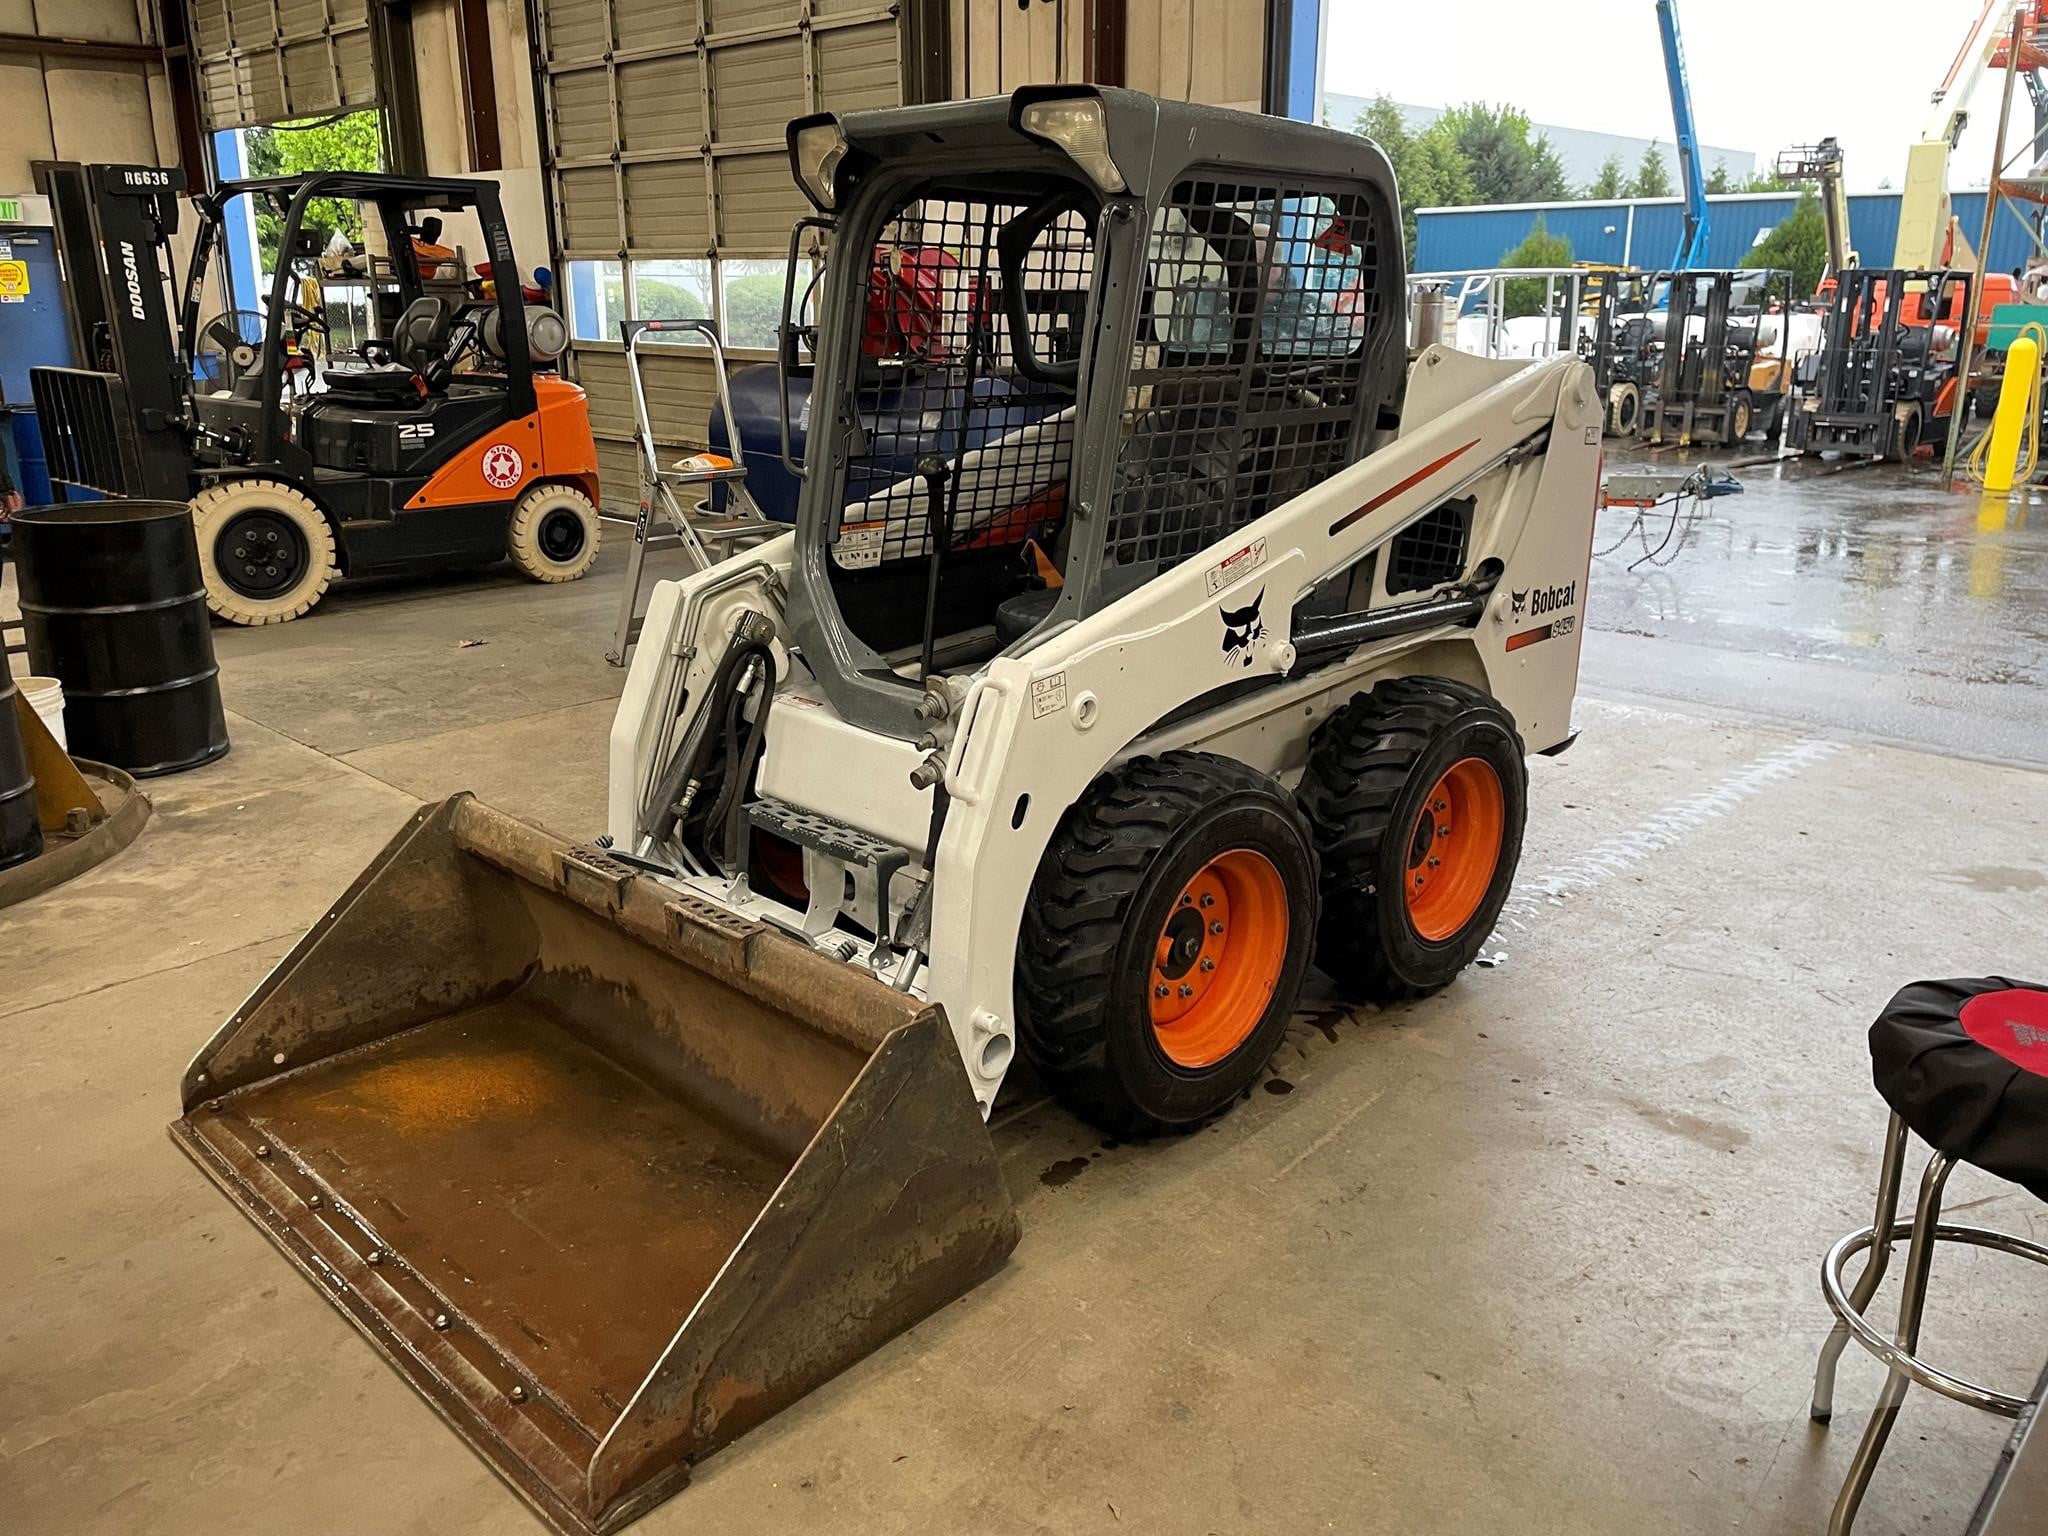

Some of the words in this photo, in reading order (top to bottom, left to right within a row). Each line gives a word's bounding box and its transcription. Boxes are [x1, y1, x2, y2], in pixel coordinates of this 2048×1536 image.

[124, 171, 169, 186] R6636
[0, 201, 18, 220] XIT
[120, 241, 145, 321] DOOSAN
[398, 423, 435, 438] 25
[490, 446, 513, 456] STAR
[487, 473, 519, 487] RENTALS
[1530, 580, 1576, 617] Bobcat
